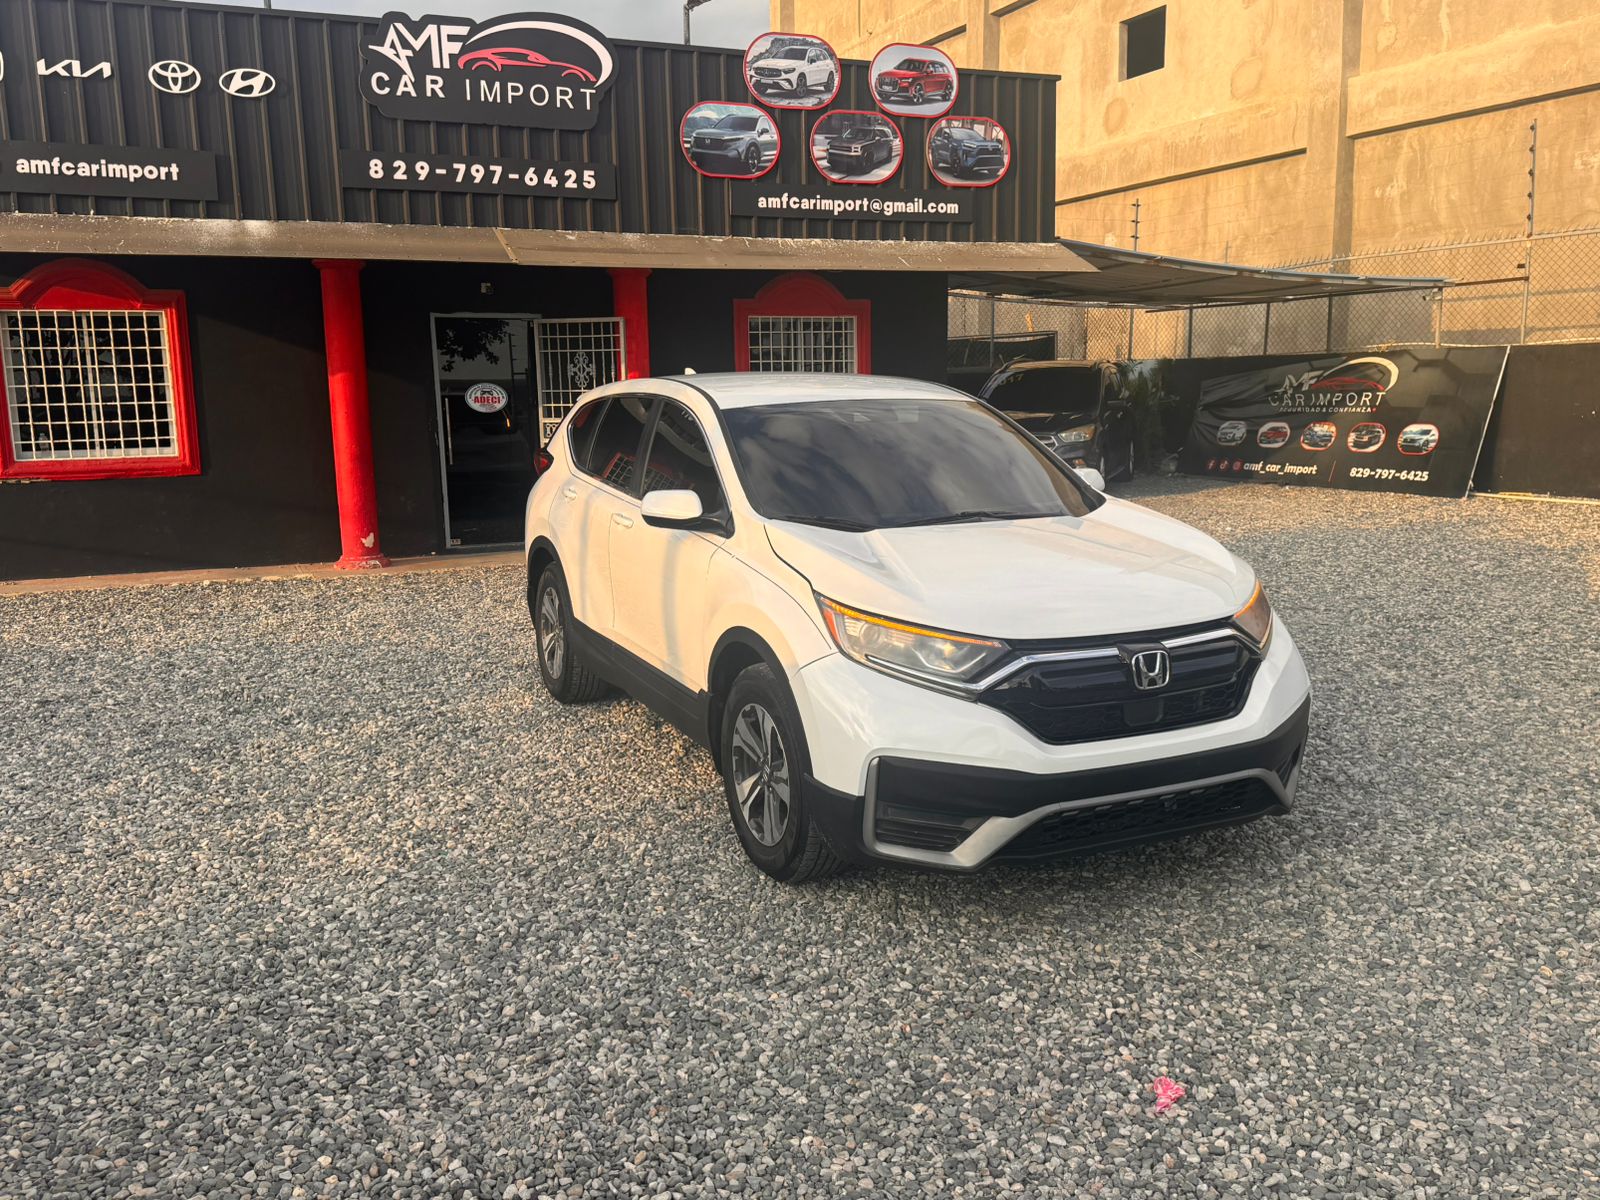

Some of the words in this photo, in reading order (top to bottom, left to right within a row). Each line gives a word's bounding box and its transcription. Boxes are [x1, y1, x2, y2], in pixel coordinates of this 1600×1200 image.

[368, 22, 471, 81] AMF
[370, 72, 446, 98] CAR
[465, 78, 597, 111] IMPORT
[15, 156, 180, 182] amfcarimport
[368, 158, 597, 190] 829-797-6425
[757, 192, 959, 216] amfcarimport@gmail.com
[473, 395, 501, 404] ADECI
[1268, 393, 1305, 407] CAR
[1309, 391, 1387, 407] IMPORT
[1243, 460, 1318, 475] amf_car_import
[1349, 466, 1430, 482] 829-797-6425
